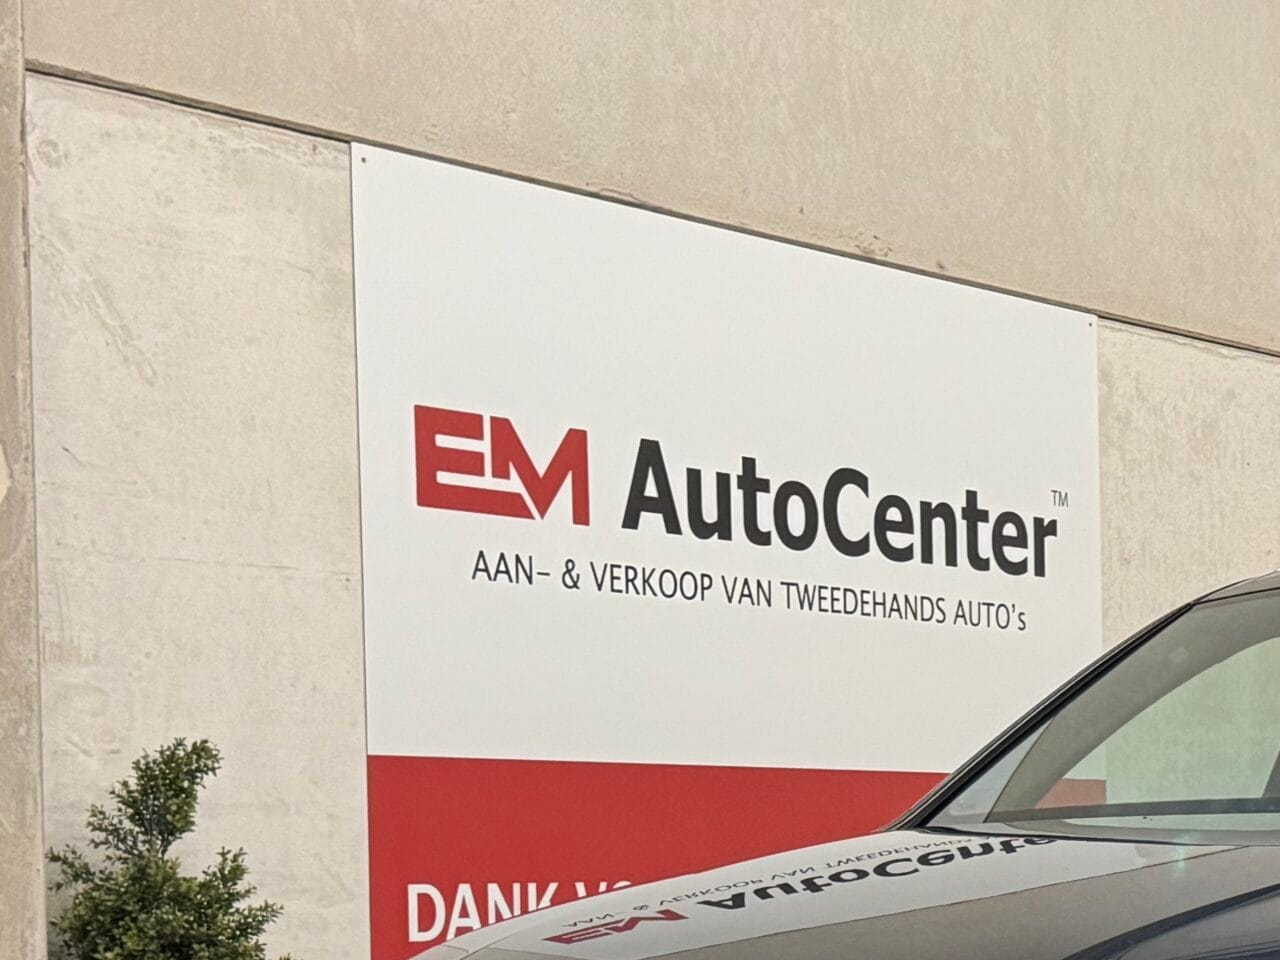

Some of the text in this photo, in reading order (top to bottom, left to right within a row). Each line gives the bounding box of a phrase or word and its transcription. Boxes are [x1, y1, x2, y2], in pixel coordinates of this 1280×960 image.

[414, 404, 590, 526] EM
[620, 438, 1058, 578] AutoCenter
[561, 558, 581, 590] &
[589, 561, 714, 602] VERKOOP
[721, 575, 773, 608] VAN
[780, 581, 947, 624] TWEEDEHANDS
[953, 599, 1027, 631] AUTO's
